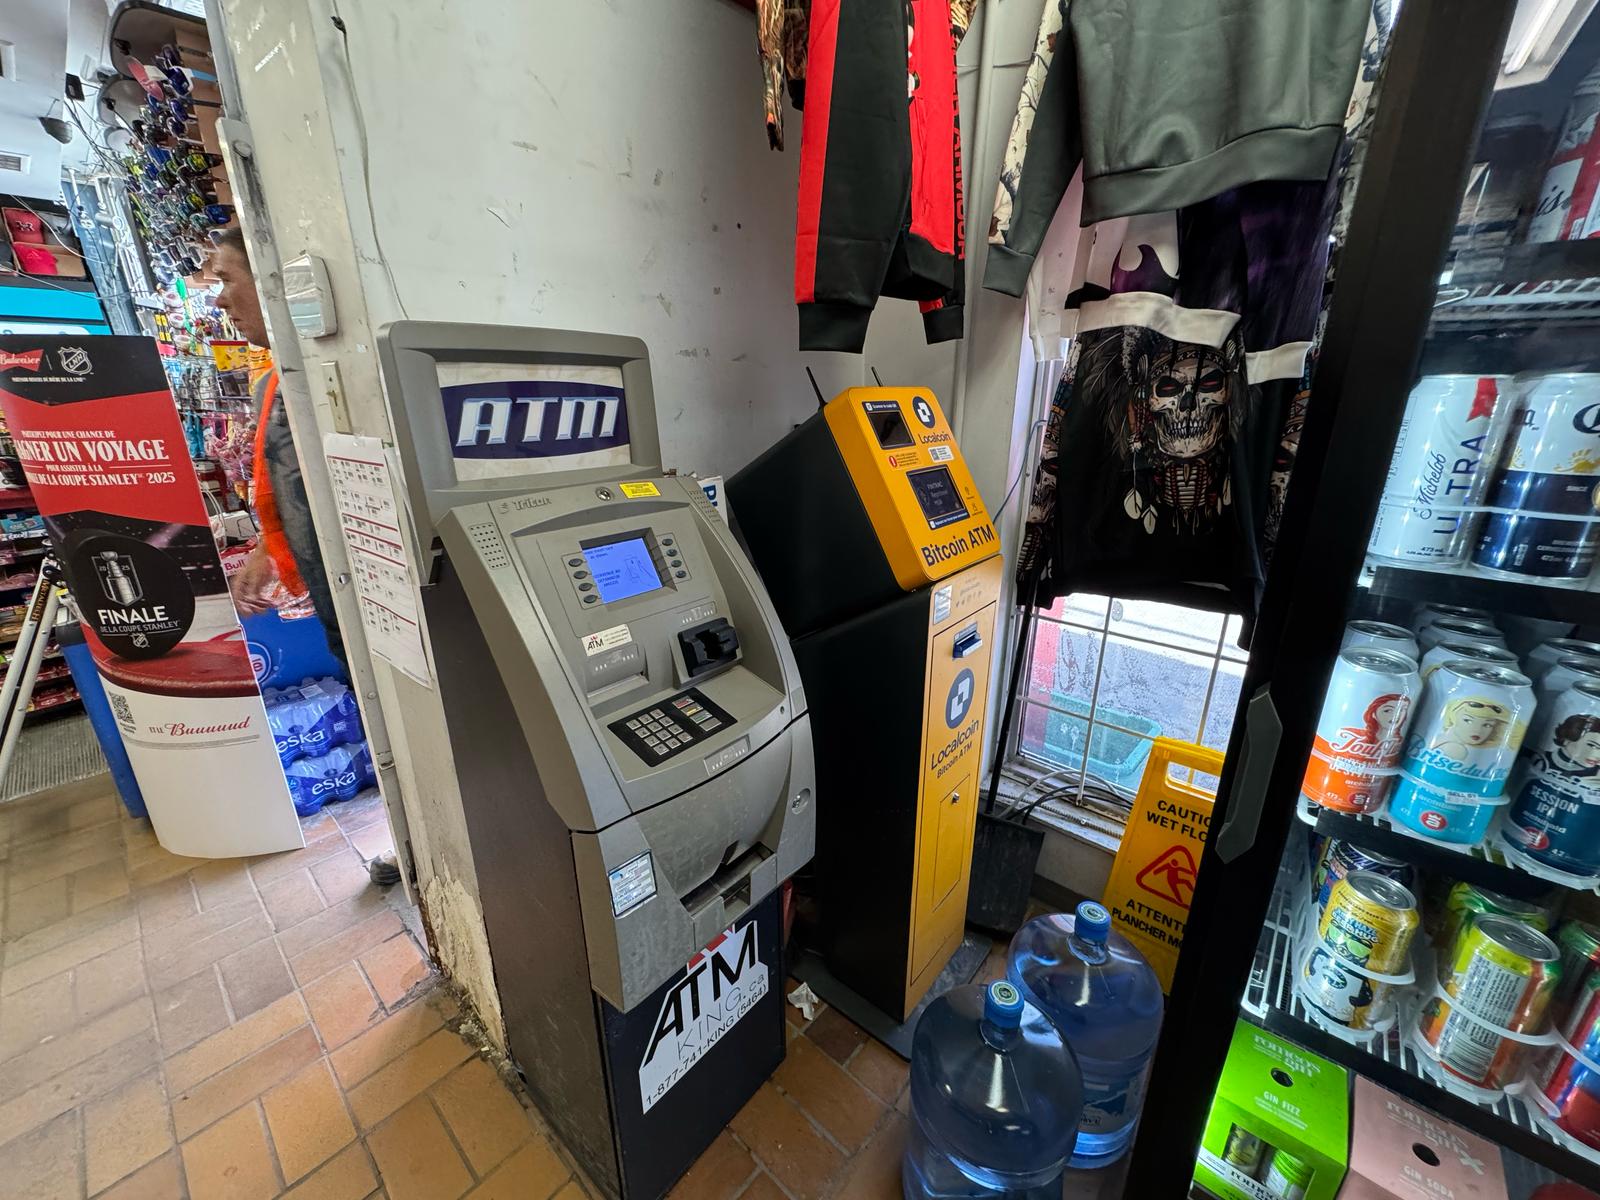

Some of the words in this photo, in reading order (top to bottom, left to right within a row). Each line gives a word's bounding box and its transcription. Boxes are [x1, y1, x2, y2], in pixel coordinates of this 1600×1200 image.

[75, 430, 103, 439] CHANCE
[105, 430, 116, 439] DE
[456, 396, 620, 447] ATM
[53, 440, 83, 463] UN
[82, 439, 170, 463] VOYAGE
[917, 430, 952, 445] Localcoin
[58, 474, 89, 486] COUPE
[146, 472, 176, 484] 2025
[94, 464, 104, 472] LA
[1413, 450, 1447, 521] Michelob
[1432, 434, 1487, 534] UTRA
[920, 535, 970, 568] Bitcoin
[969, 523, 995, 549] ATM
[224, 559, 246, 571] Bull
[98, 605, 170, 625] FINALE
[108, 625, 118, 633] LA
[119, 624, 143, 632] COUPE
[142, 620, 179, 632] STANLEY
[588, 638, 605, 651] ATM
[276, 729, 326, 753] eska
[931, 719, 979, 771] Localcoin
[936, 755, 958, 779] Bitcoin
[958, 741, 973, 759] ATM
[311, 769, 357, 796] eska
[1530, 784, 1580, 815] SESSION
[1536, 801, 1557, 819] IPA
[1146, 810, 1178, 832] WET
[1112, 906, 1167, 944] PLANCHER
[643, 920, 757, 1068] ATM
[647, 1015, 734, 1105] 1-877-741-KING
[736, 984, 767, 1020] (5464)
[1263, 1090, 1279, 1105] GIN
[1282, 1100, 1300, 1117] FIZZ
[1402, 1165, 1422, 1180] GIN
[1426, 1177, 1456, 1200] SODA
